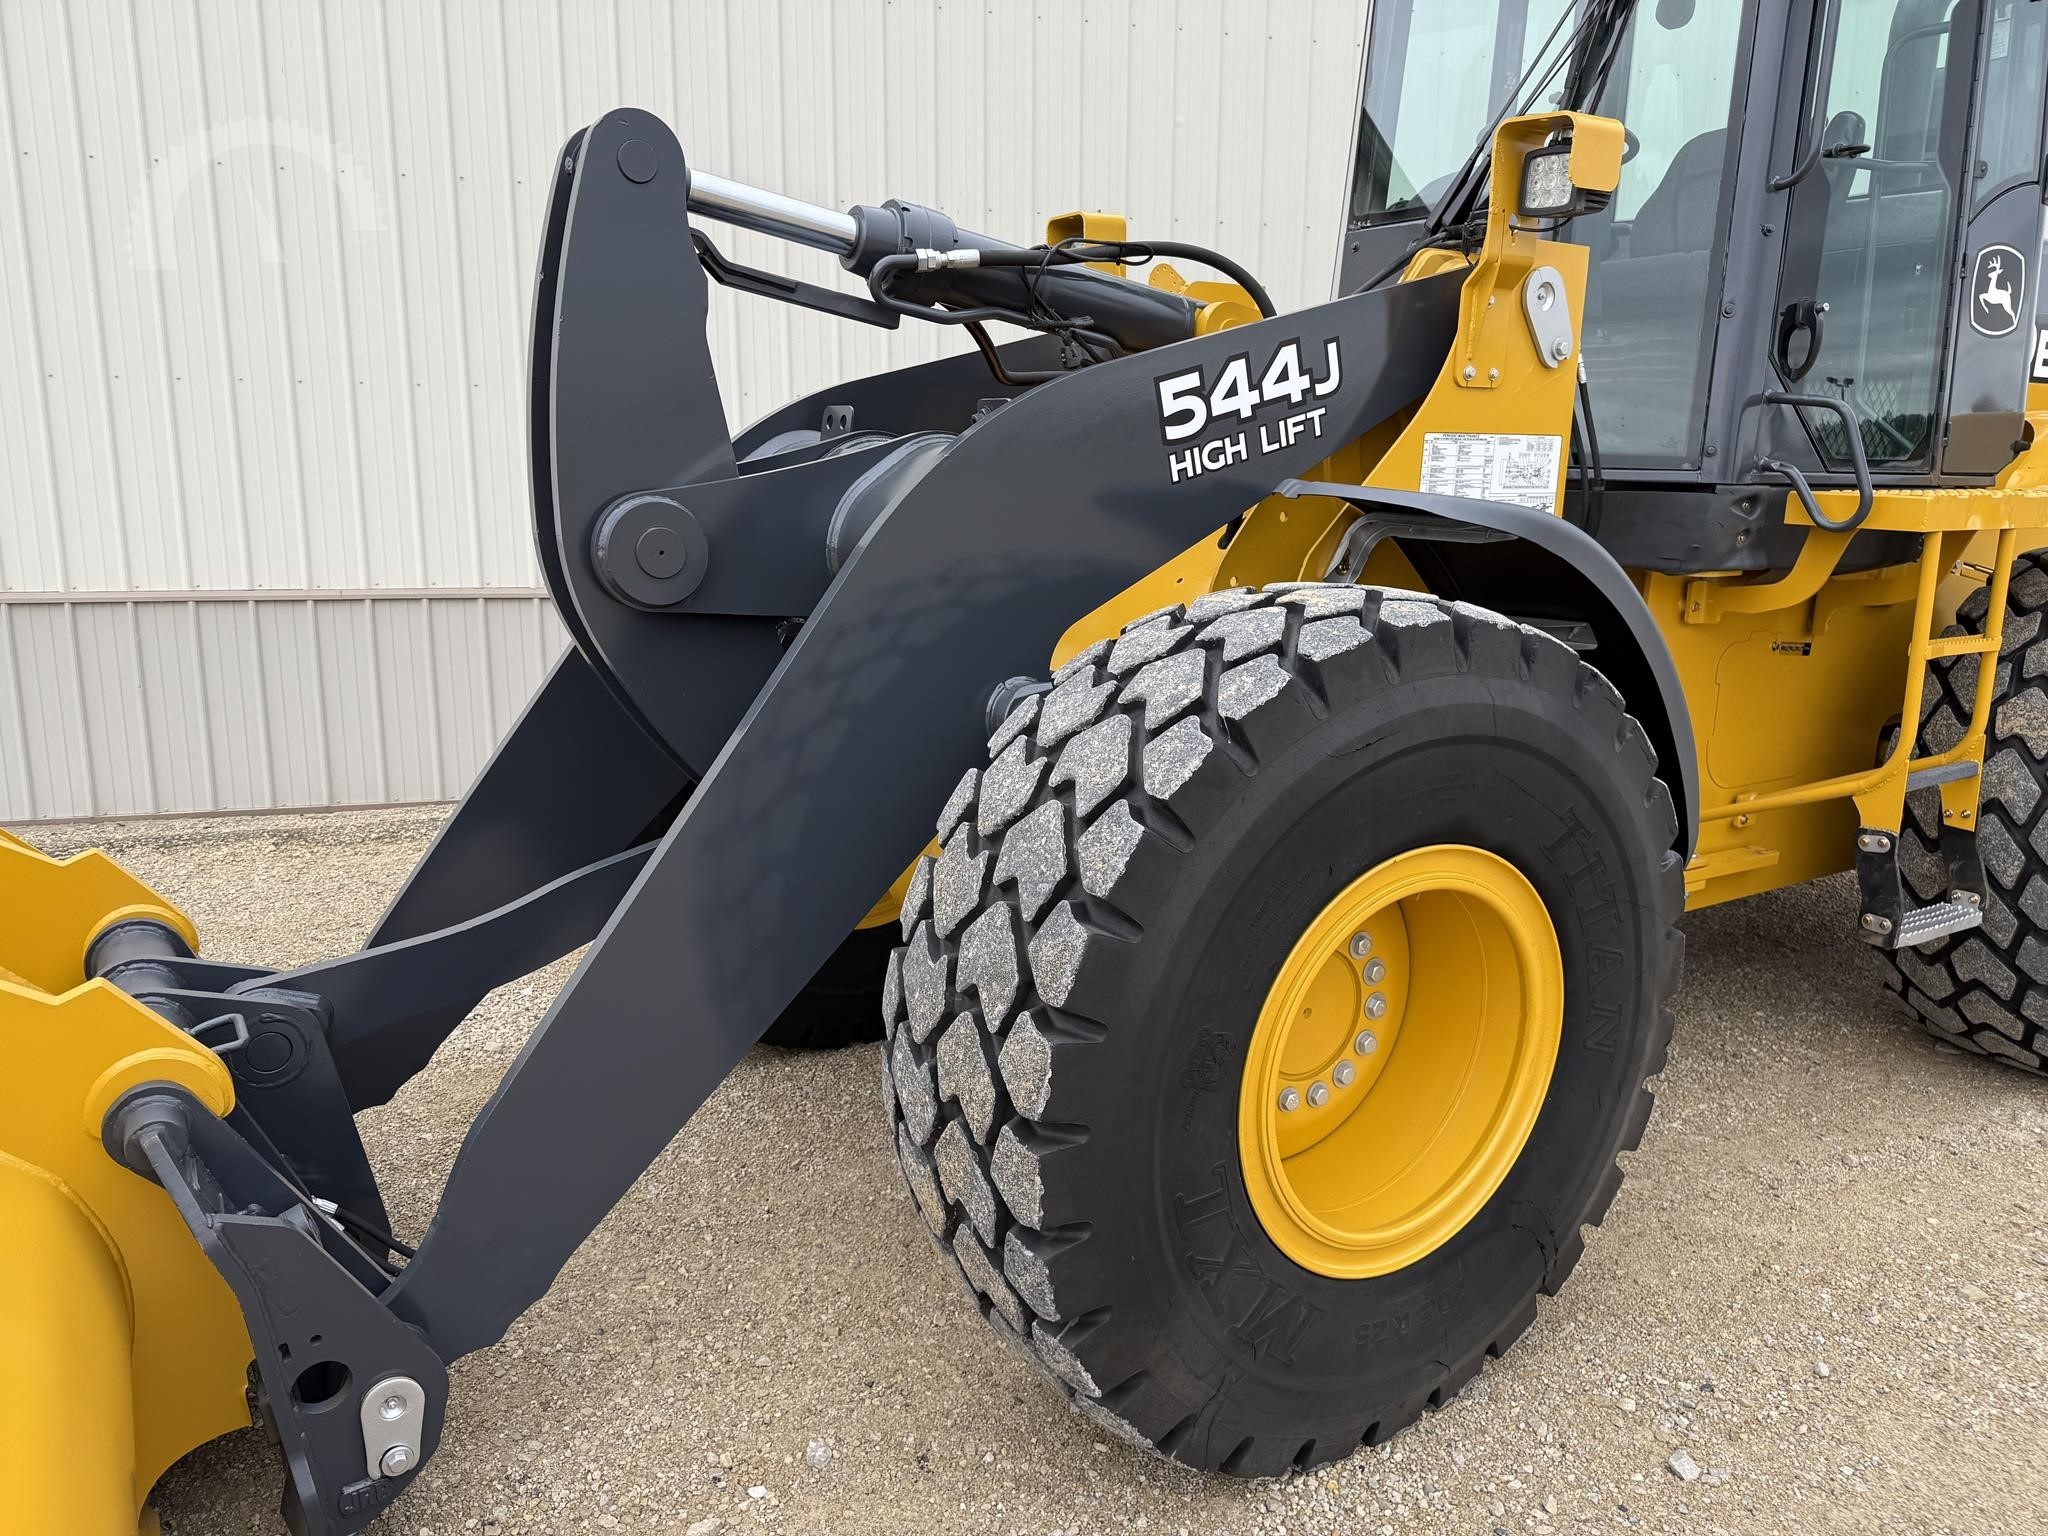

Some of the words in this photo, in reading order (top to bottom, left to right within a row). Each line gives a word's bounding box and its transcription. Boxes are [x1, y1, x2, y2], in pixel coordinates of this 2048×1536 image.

[1159, 341, 1340, 441] 544J
[1169, 432, 1248, 483] HIGH
[1260, 407, 1327, 453] LIFT
[1540, 804, 1624, 1063] TITAN
